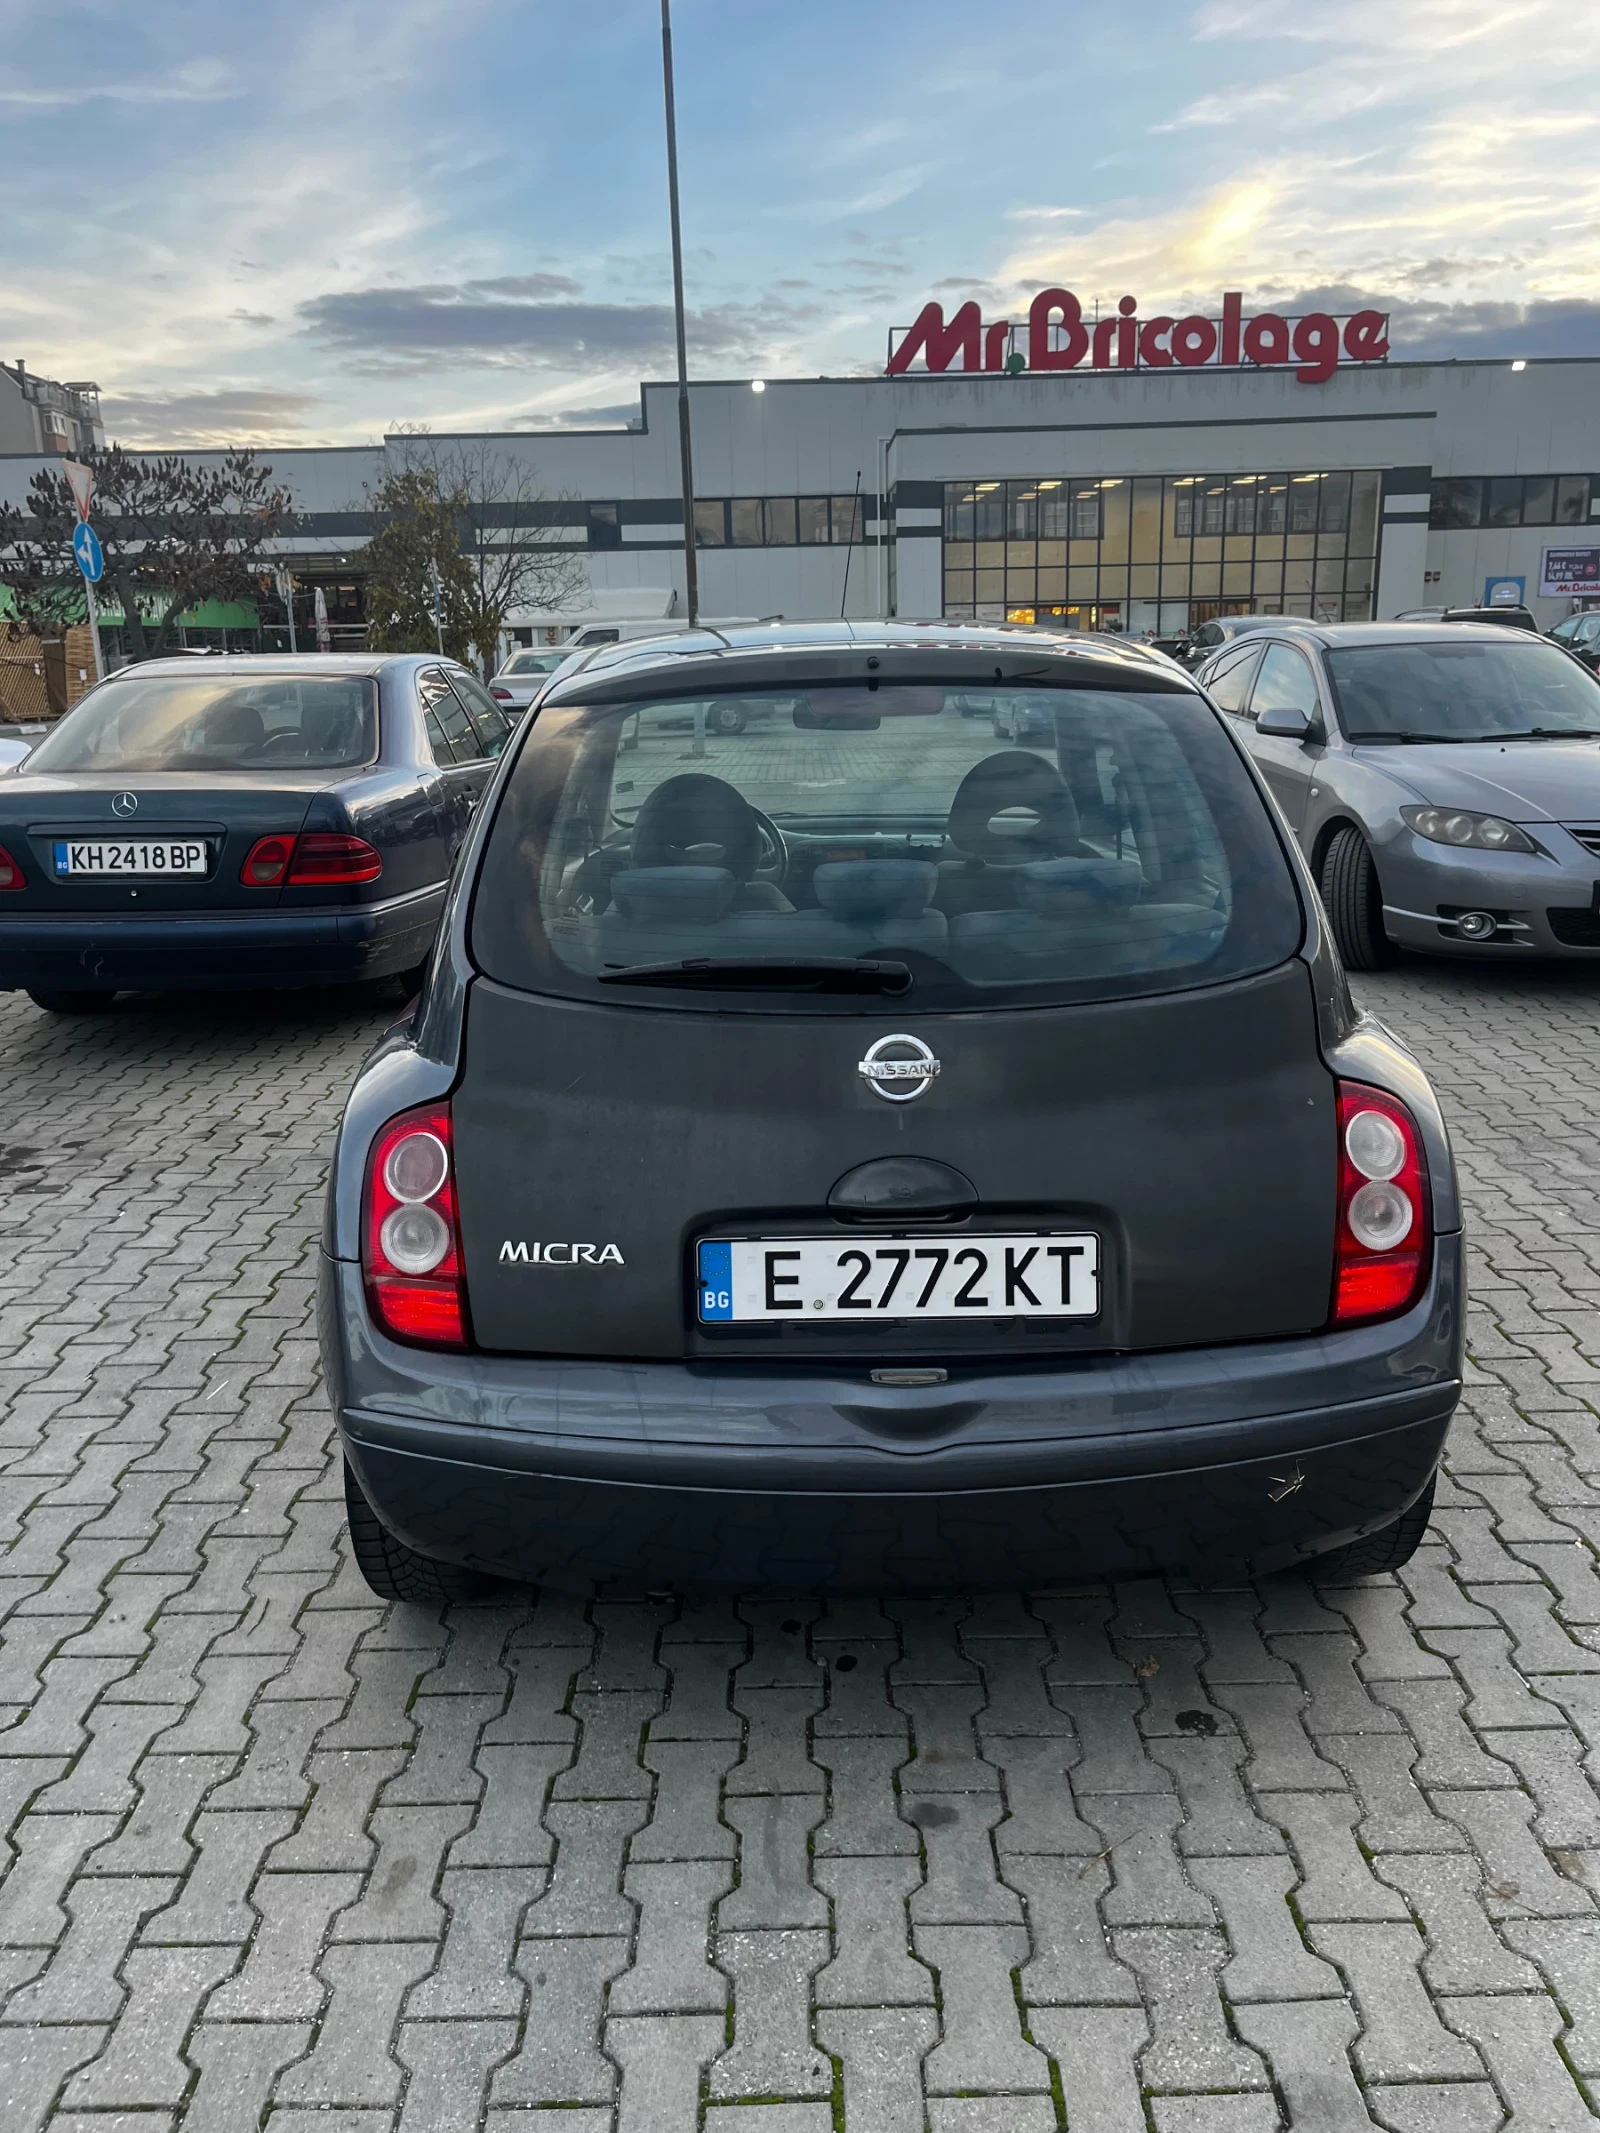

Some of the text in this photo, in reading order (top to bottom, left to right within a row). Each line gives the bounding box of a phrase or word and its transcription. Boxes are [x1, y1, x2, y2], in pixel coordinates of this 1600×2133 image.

[1029, 288, 1391, 384] Bricolage
[868, 1063, 932, 1076] NISSAN
[499, 1240, 626, 1265] MICRA
[764, 1250, 804, 1311] E
[703, 1290, 730, 1309] BG
